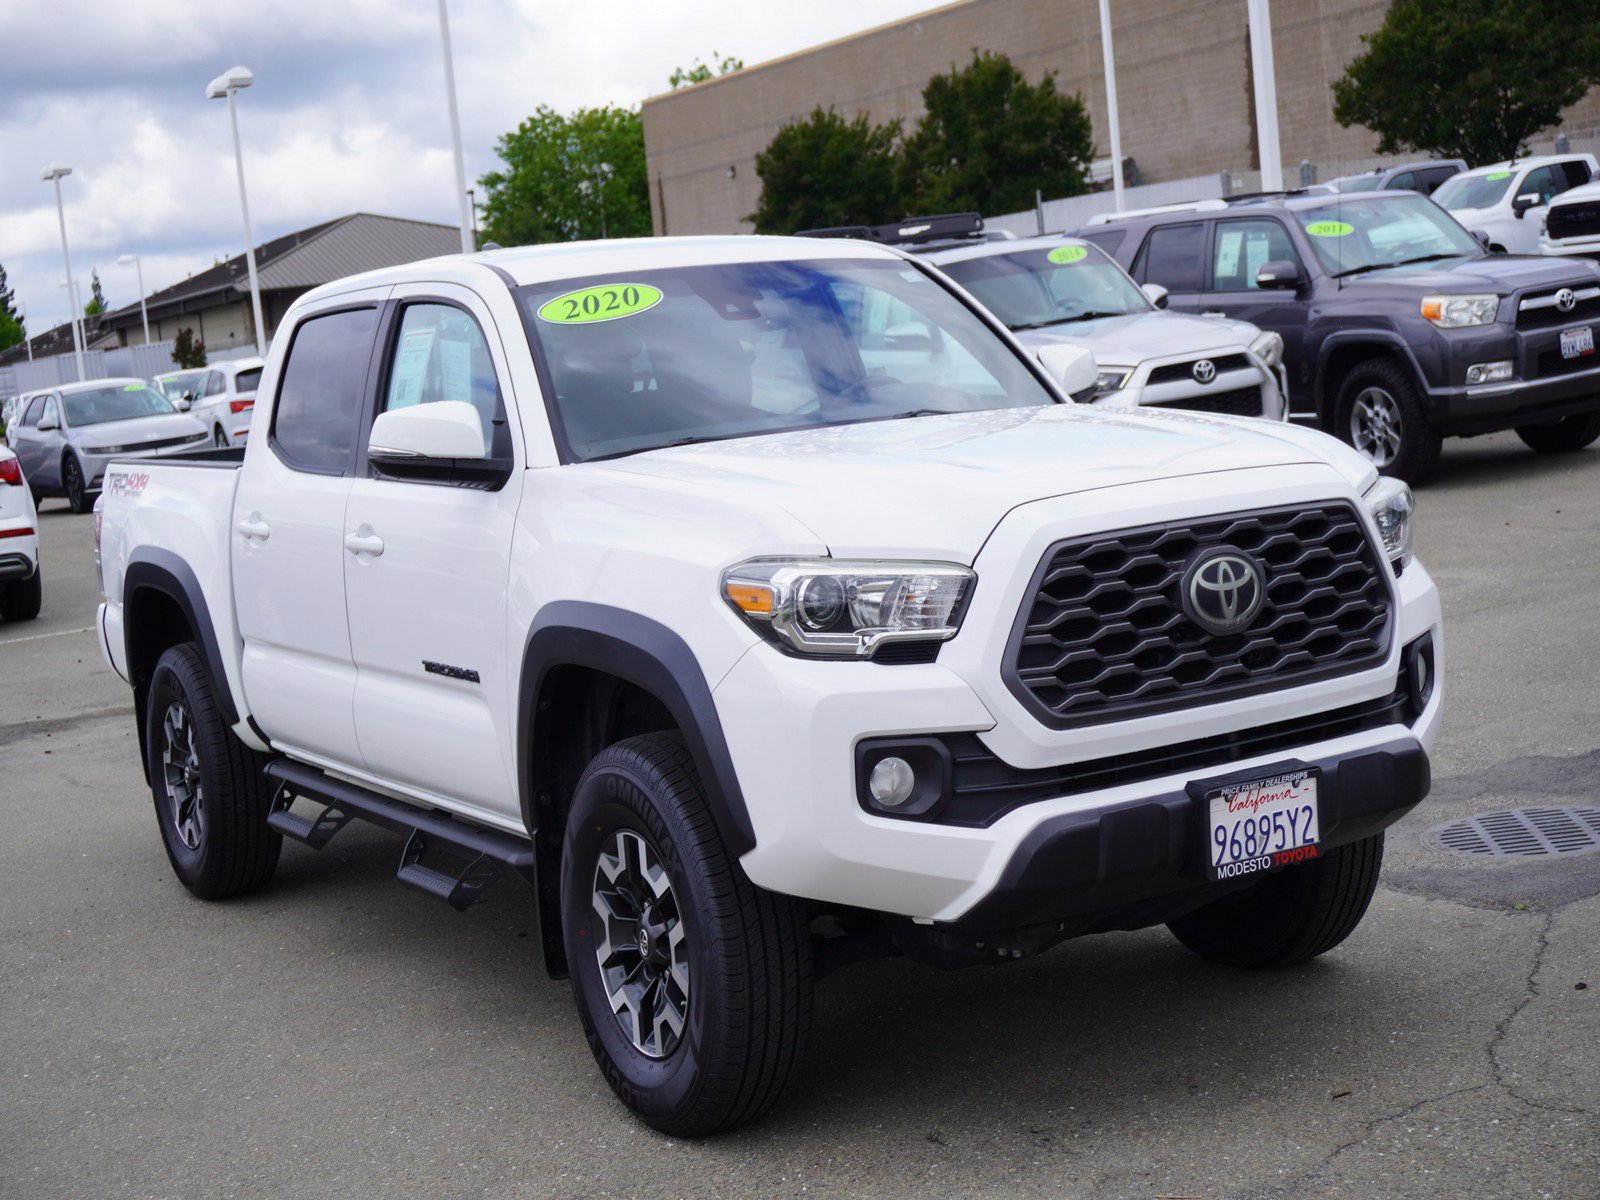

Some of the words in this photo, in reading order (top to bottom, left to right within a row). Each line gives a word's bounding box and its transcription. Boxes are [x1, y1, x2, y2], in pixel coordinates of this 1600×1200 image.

[562, 287, 640, 320] 2020
[1221, 786, 1241, 797] PRICE
[1241, 781, 1266, 793] FAMILY
[1266, 772, 1308, 787] DEALERSHIPS
[1228, 788, 1299, 814] California
[1214, 805, 1315, 866] 96895Y2
[1217, 856, 1271, 880] MODESTO
[1273, 845, 1318, 866] TOYOTA
